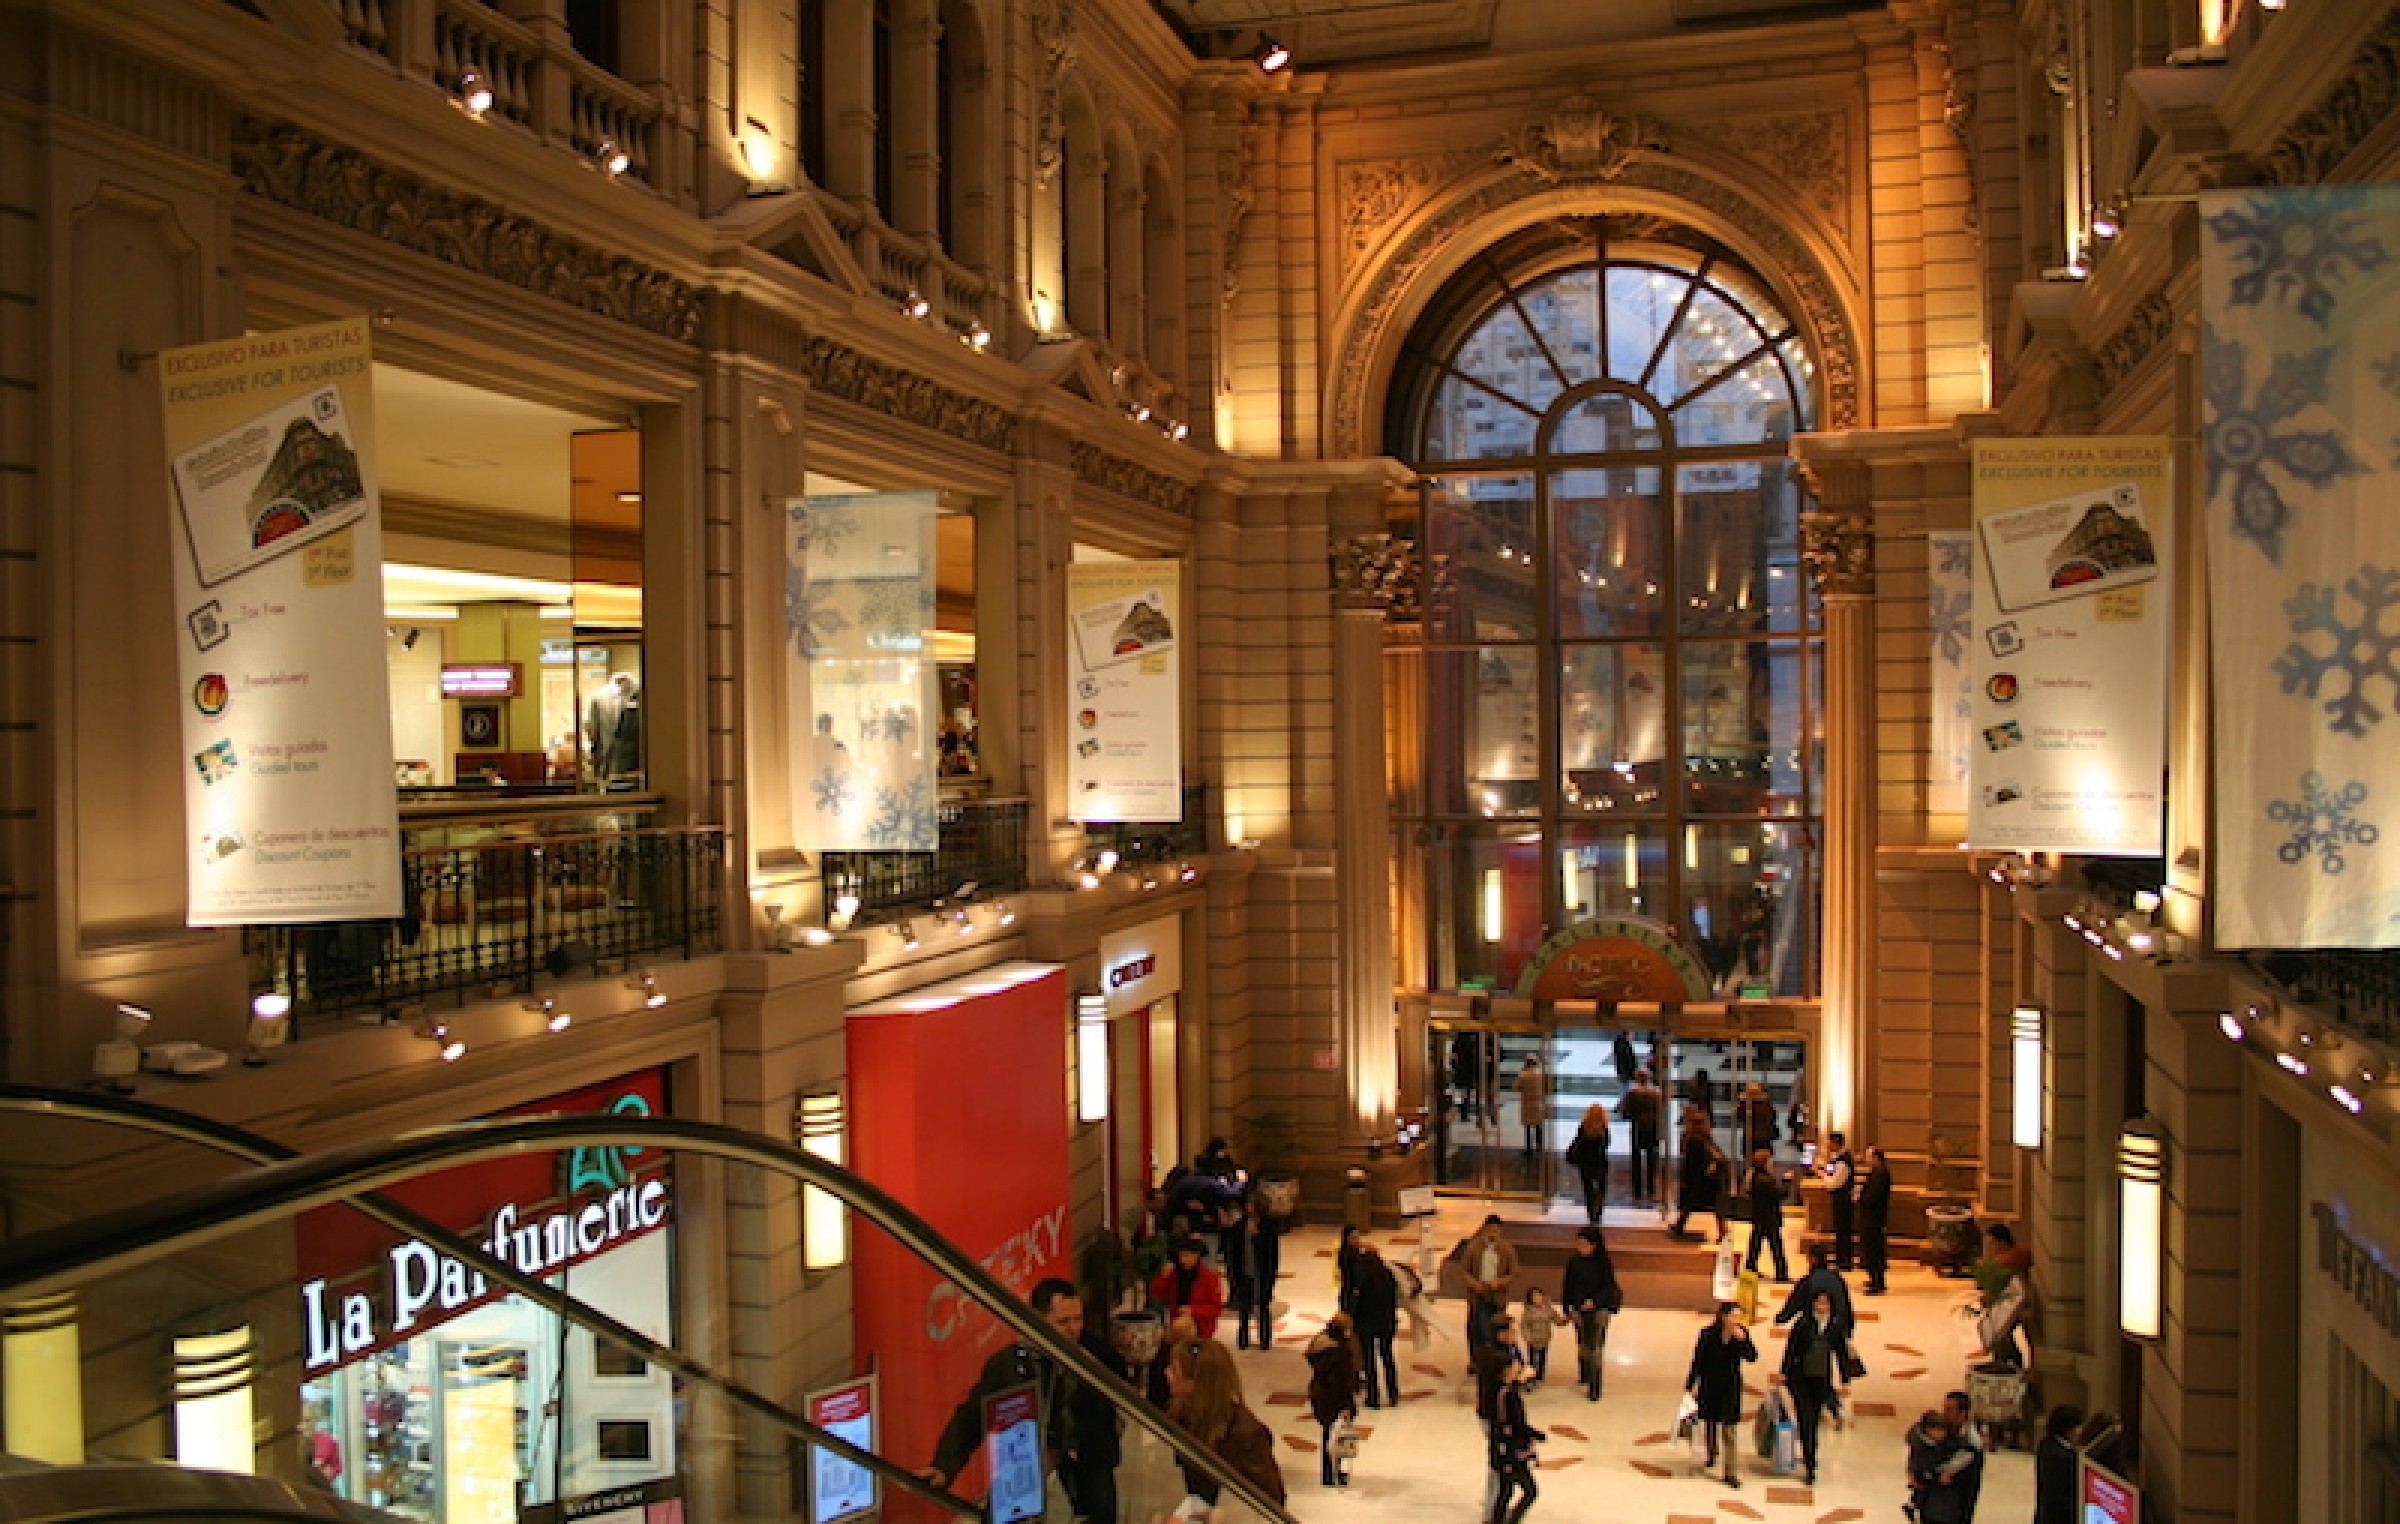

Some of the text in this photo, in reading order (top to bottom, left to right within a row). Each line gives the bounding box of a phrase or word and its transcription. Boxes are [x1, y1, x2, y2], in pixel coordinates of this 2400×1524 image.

[167, 328, 362, 374] EXCLUSIVO PARA TURISTAS
[170, 357, 364, 402] EXCLUSIVE FOR TOURISTS
[1980, 448, 2161, 462] EXCLUSIVO PARA TURISTAS
[1980, 465, 2161, 478] EXCLUSIVE FOR TOURISTS
[302, 1280, 376, 1368] La
